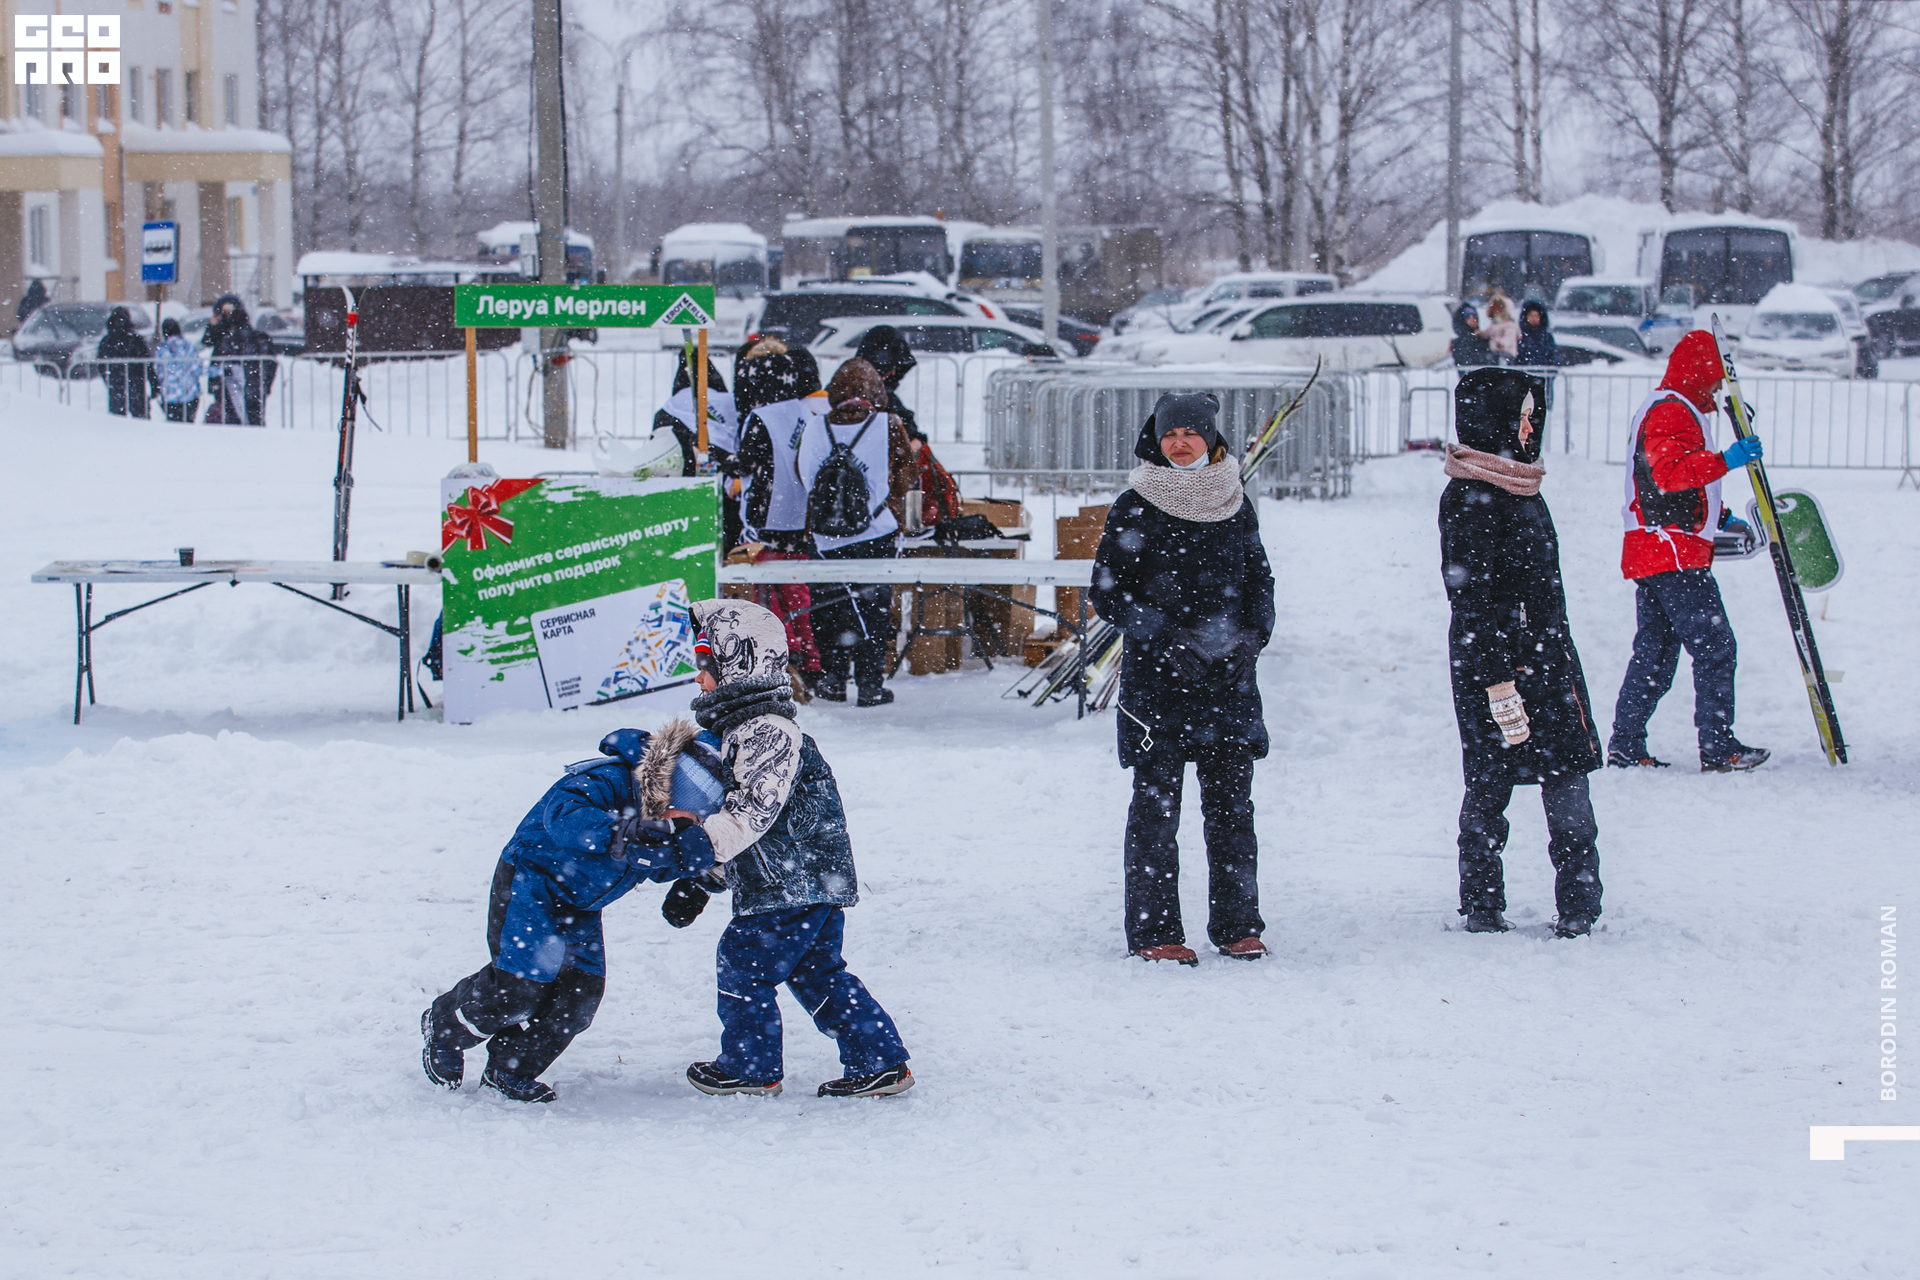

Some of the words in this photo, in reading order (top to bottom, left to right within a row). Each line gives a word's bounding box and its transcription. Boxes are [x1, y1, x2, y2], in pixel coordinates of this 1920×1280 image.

[476, 295, 548, 320] Леруа
[555, 296, 646, 320] Мерлен
[662, 301, 683, 324] LEROY
[682, 297, 708, 324] MERLIN
[707, 405, 726, 424] RLIN
[472, 551, 553, 582] Оформите
[555, 529, 642, 559] сервисную
[644, 516, 690, 539] карту
[478, 573, 553, 601] получите
[555, 553, 621, 581] подарок
[540, 608, 596, 630] СЕРВИСНАЯ
[543, 626, 574, 641] КАРТА
[664, 656, 679, 678] LEROY
[676, 652, 696, 667] MERLI
